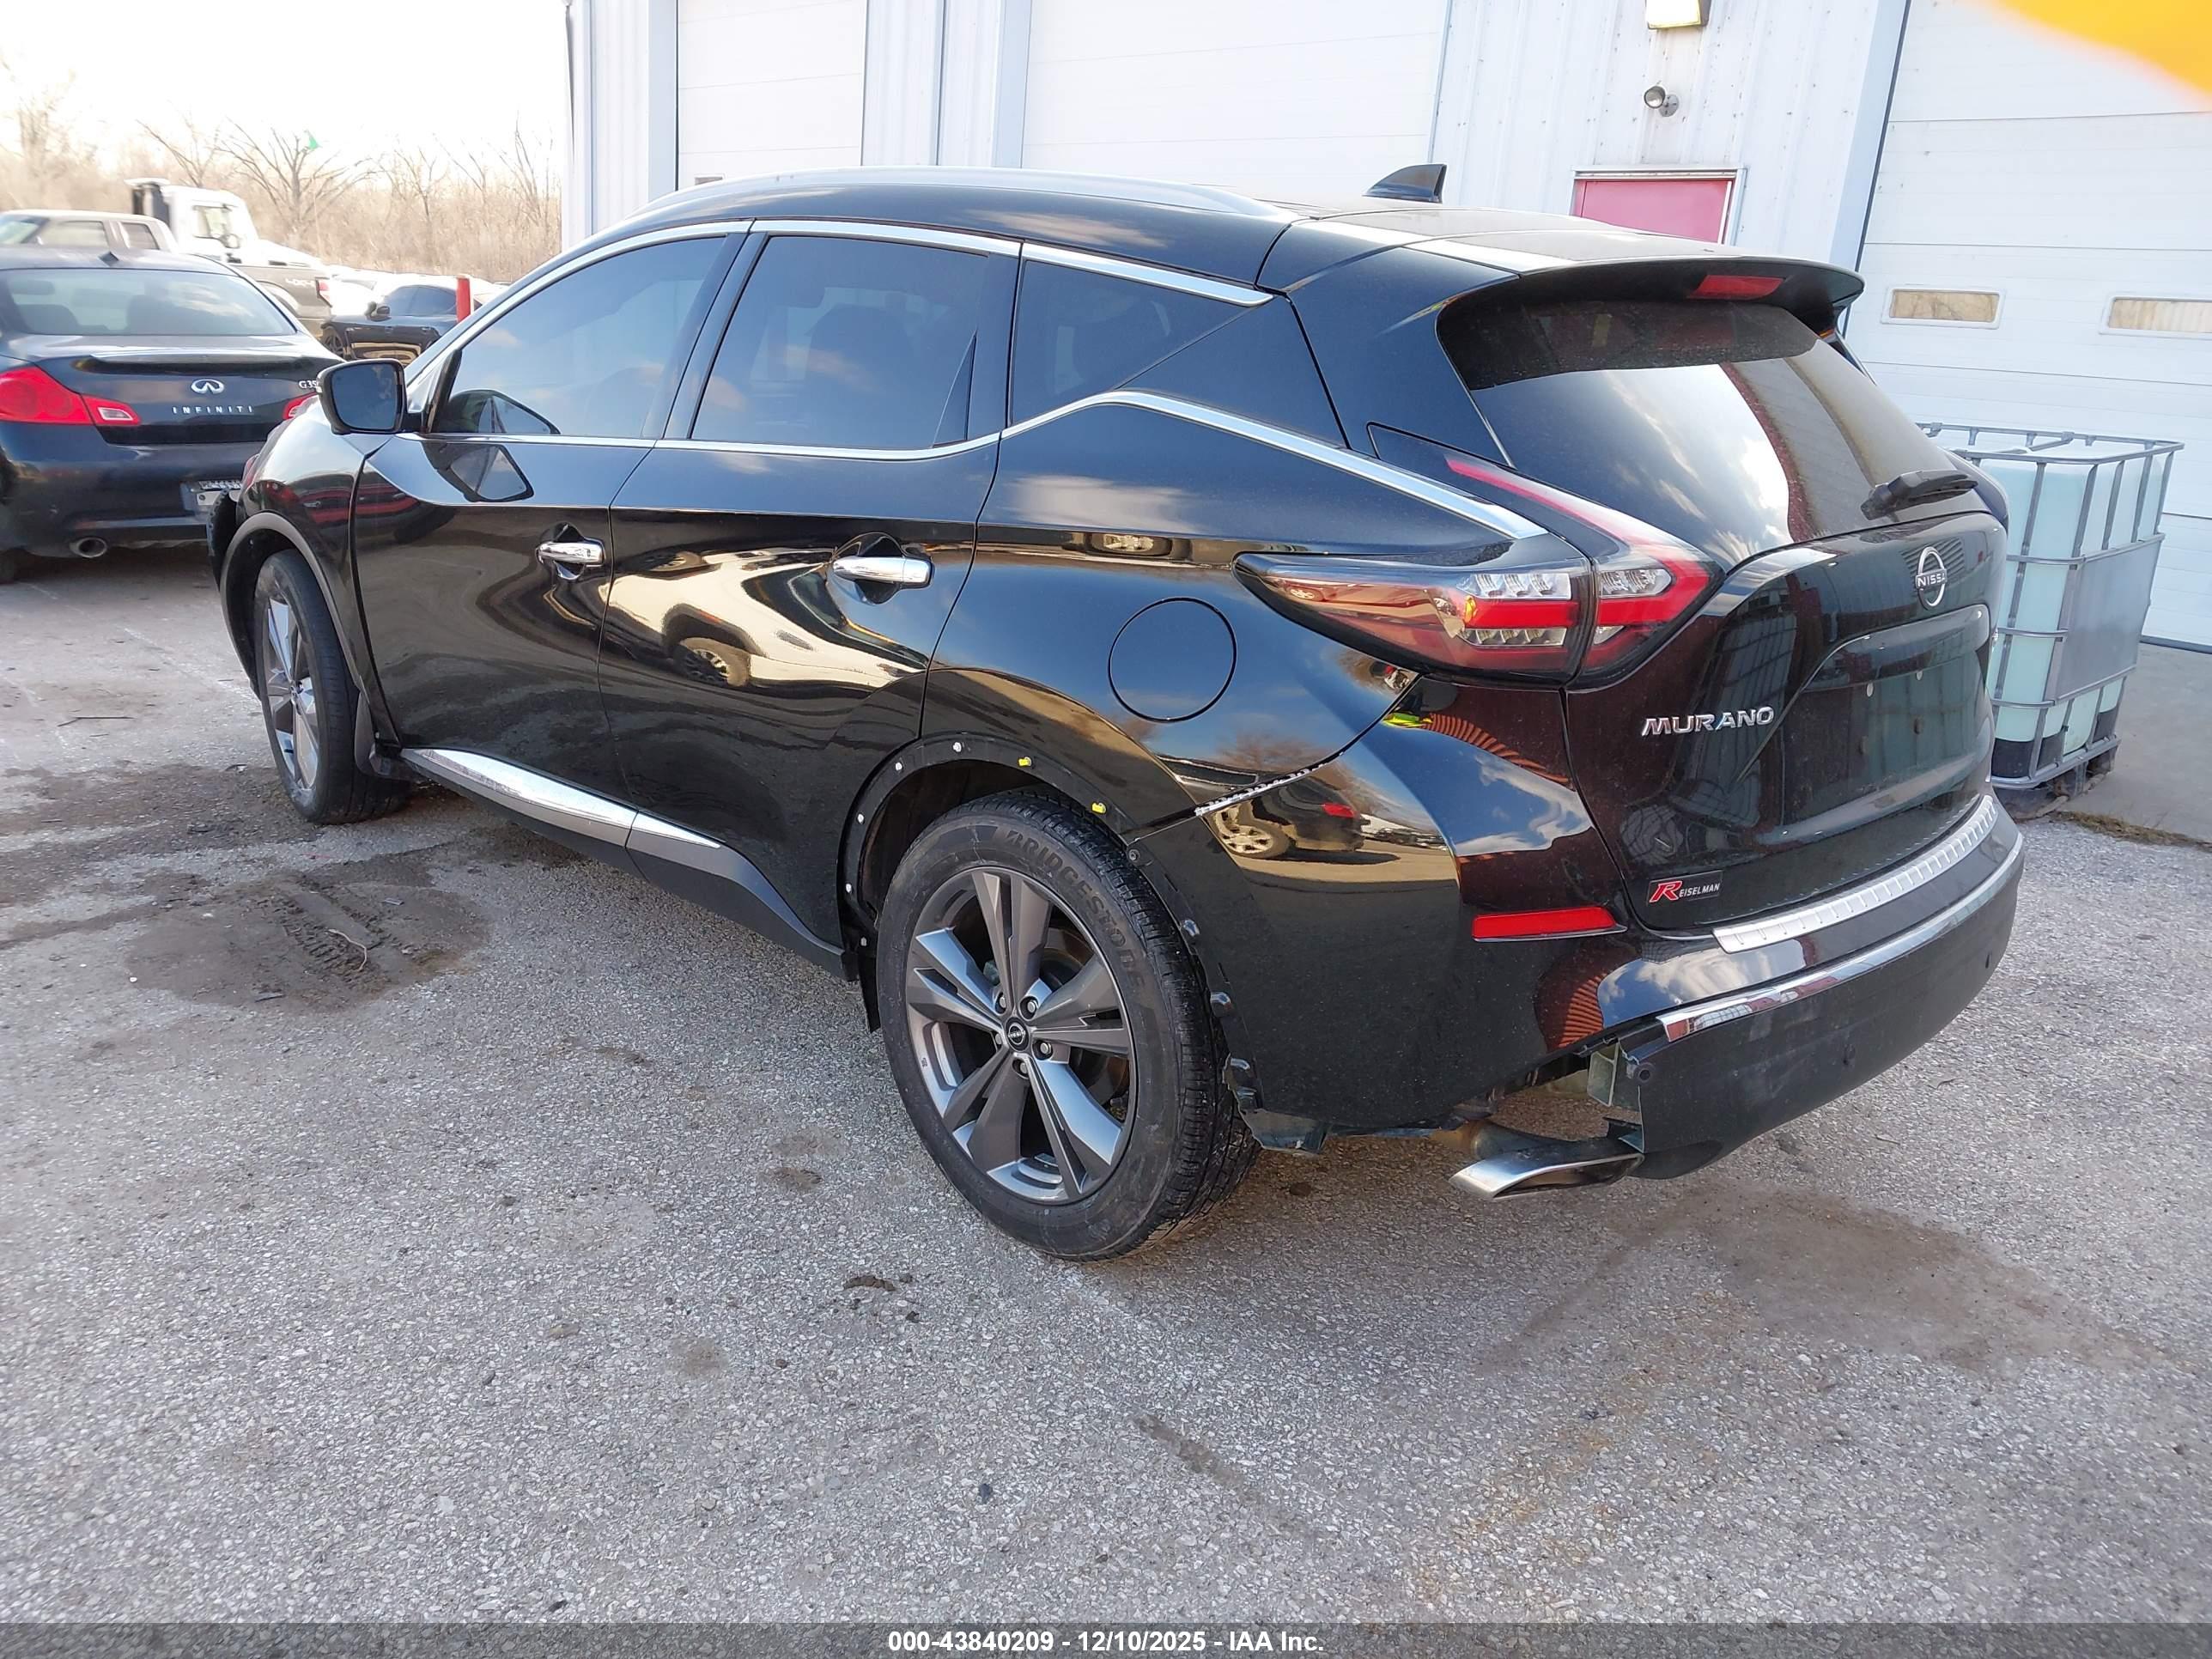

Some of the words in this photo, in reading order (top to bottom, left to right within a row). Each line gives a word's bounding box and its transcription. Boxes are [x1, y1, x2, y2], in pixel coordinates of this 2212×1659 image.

[172, 404, 253, 415] INFINITI
[1917, 572, 1947, 588] NISSA
[1640, 706, 1775, 737] MURANO
